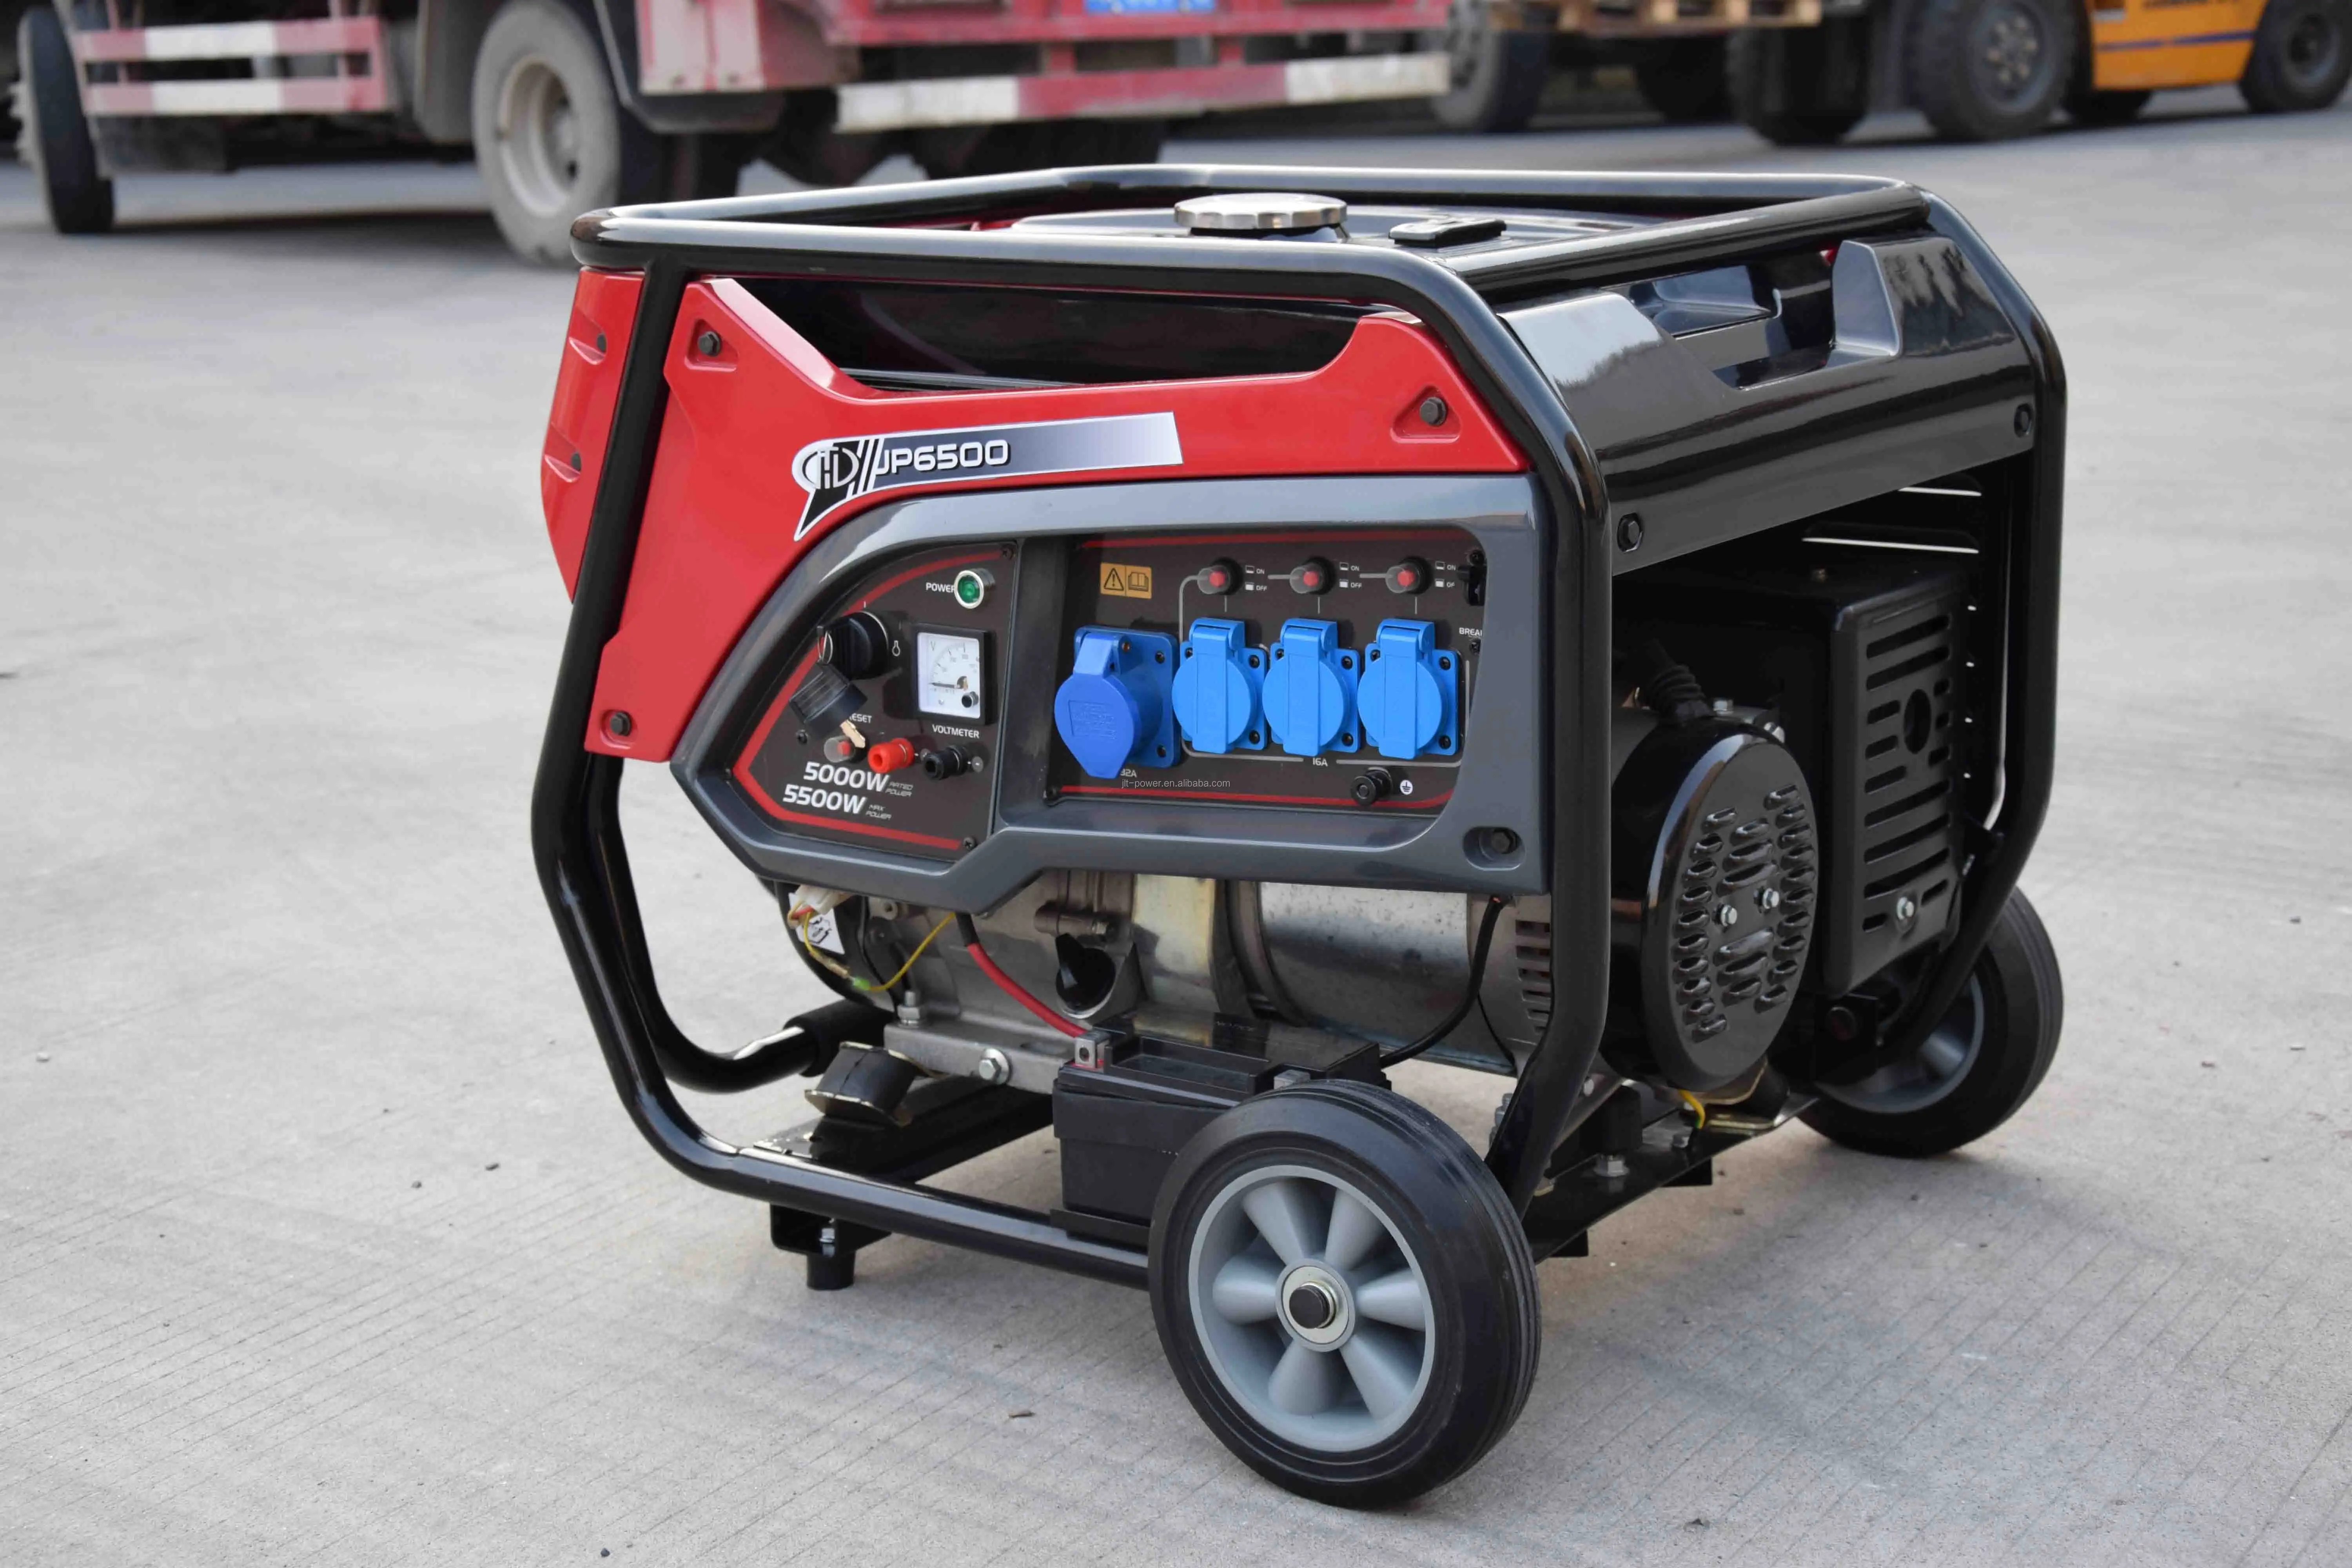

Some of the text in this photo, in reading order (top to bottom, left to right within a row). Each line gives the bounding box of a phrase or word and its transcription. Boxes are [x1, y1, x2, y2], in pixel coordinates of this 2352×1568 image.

[874, 439, 1011, 475] JP6500
[849, 713, 872, 724] ESET
[932, 724, 980, 739] VOLTMETER
[803, 761, 890, 792] 5000W
[783, 784, 867, 814] 5500W
